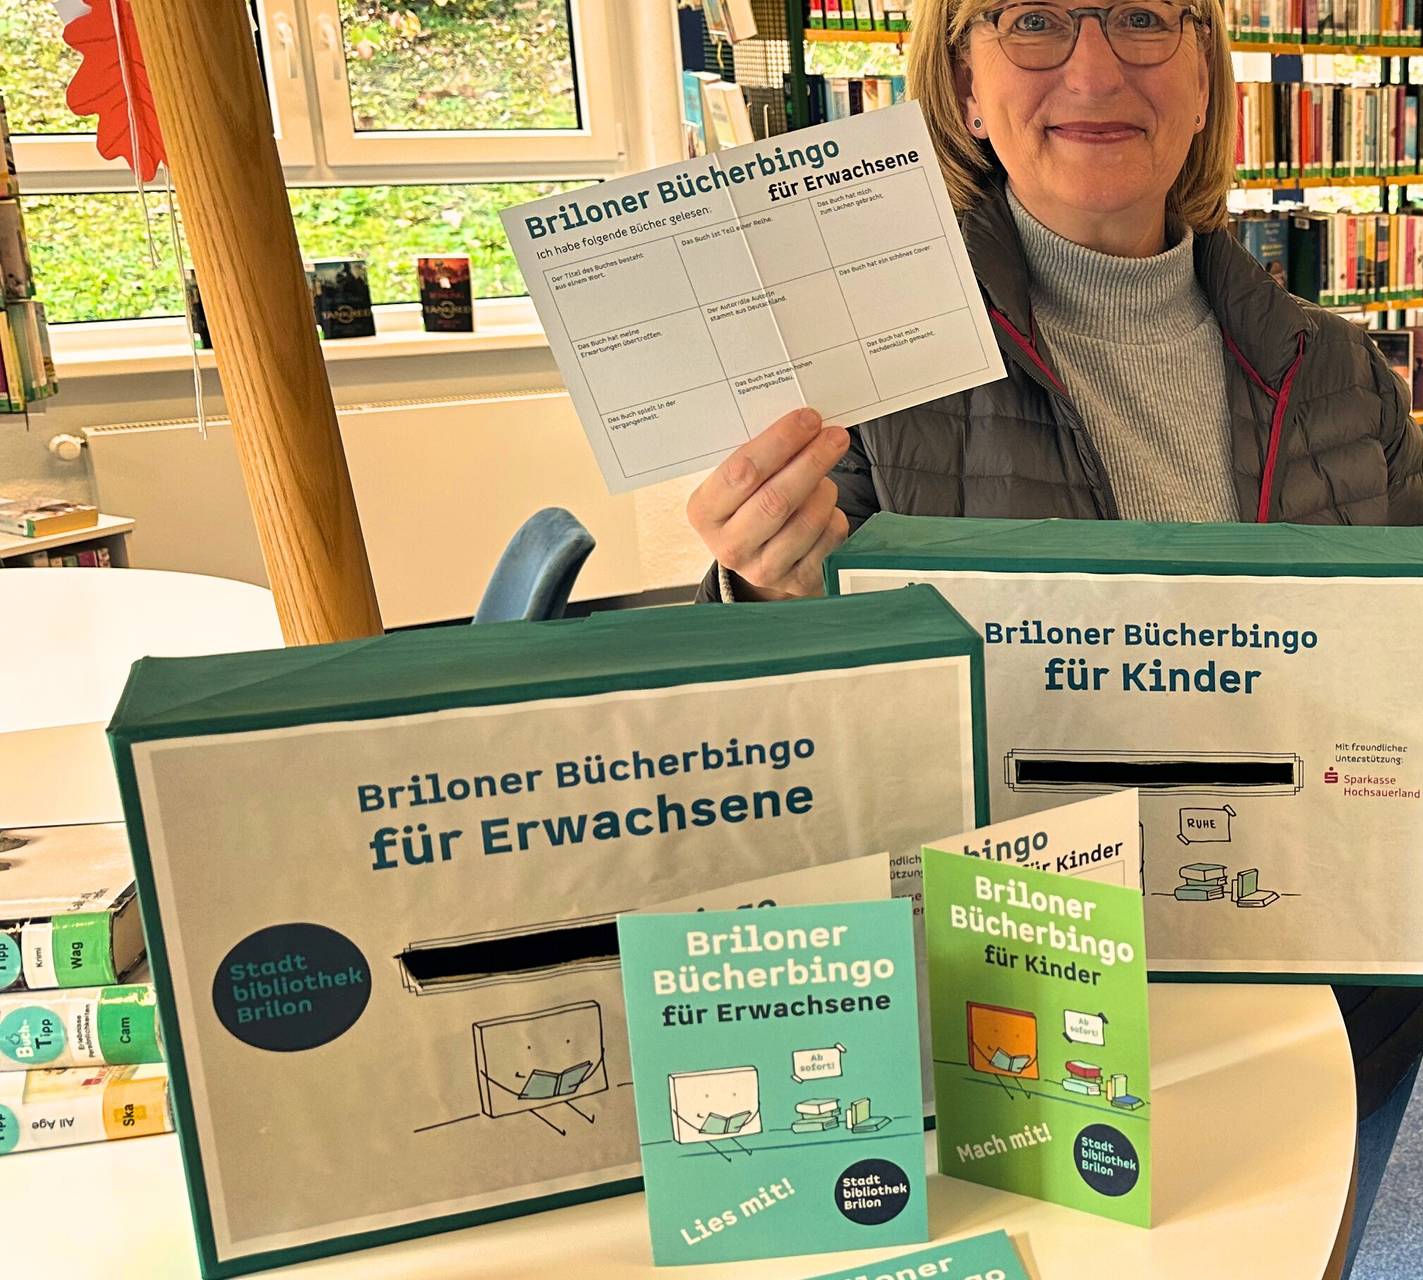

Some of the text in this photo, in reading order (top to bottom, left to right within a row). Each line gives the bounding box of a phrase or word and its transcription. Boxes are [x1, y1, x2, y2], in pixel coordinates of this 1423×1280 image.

[524, 139, 839, 239] Briloner Bücherbingo
[767, 149, 919, 202] für Erwachsene
[535, 247, 553, 260] Ich
[553, 241, 581, 255] habe
[581, 227, 628, 247] folgende
[628, 217, 667, 234] Bücher
[550, 252, 644, 283] Der Titel des Buches besteht
[554, 282, 567, 291] aus
[566, 277, 588, 287] einem
[985, 621, 1319, 655] Briloner Bücherbingo
[1044, 659, 1262, 695] für Kinder
[1335, 742, 1408, 753] Mit freundlicher
[357, 737, 816, 813] Briloner Bücherbingo
[1344, 774, 1397, 786] Sparkasse
[1344, 787, 1421, 799] Hochsauerland
[368, 784, 815, 871] für Erwachsene
[1186, 818, 1217, 829] RUHE
[1056, 842, 1124, 873] Kinder
[975, 875, 1097, 921] Briloner
[687, 924, 848, 957] Briloner
[950, 904, 1135, 966] Bücherbingo
[71, 940, 84, 970] Wag
[230, 954, 308, 981] Stadt
[984, 944, 1102, 986] für Kinder
[233, 966, 363, 1002] bibliothek
[653, 955, 895, 996] Bücherbingo
[237, 999, 313, 1024] Brilon
[662, 994, 891, 1027] für Erwachsene
[35, 1018, 53, 1050] Tipp
[77, 1014, 85, 1050] Erlebnisse
[119, 1016, 131, 1044] Cam
[800, 1062, 835, 1073] sofort!
[810, 1054, 824, 1063] Ab
[31, 1116, 75, 1130] All Age
[123, 1103, 135, 1127] Ska
[956, 1122, 1054, 1164] Mach mit!
[1081, 1136, 1114, 1153] Stadt
[1081, 1147, 1137, 1171] bibliothek
[1081, 1160, 1114, 1177] Brilon
[842, 1174, 881, 1187] Stadt
[843, 1183, 907, 1199] bibliothek
[680, 1177, 796, 1246] Lies mit!
[844, 1198, 882, 1211] Brilon
